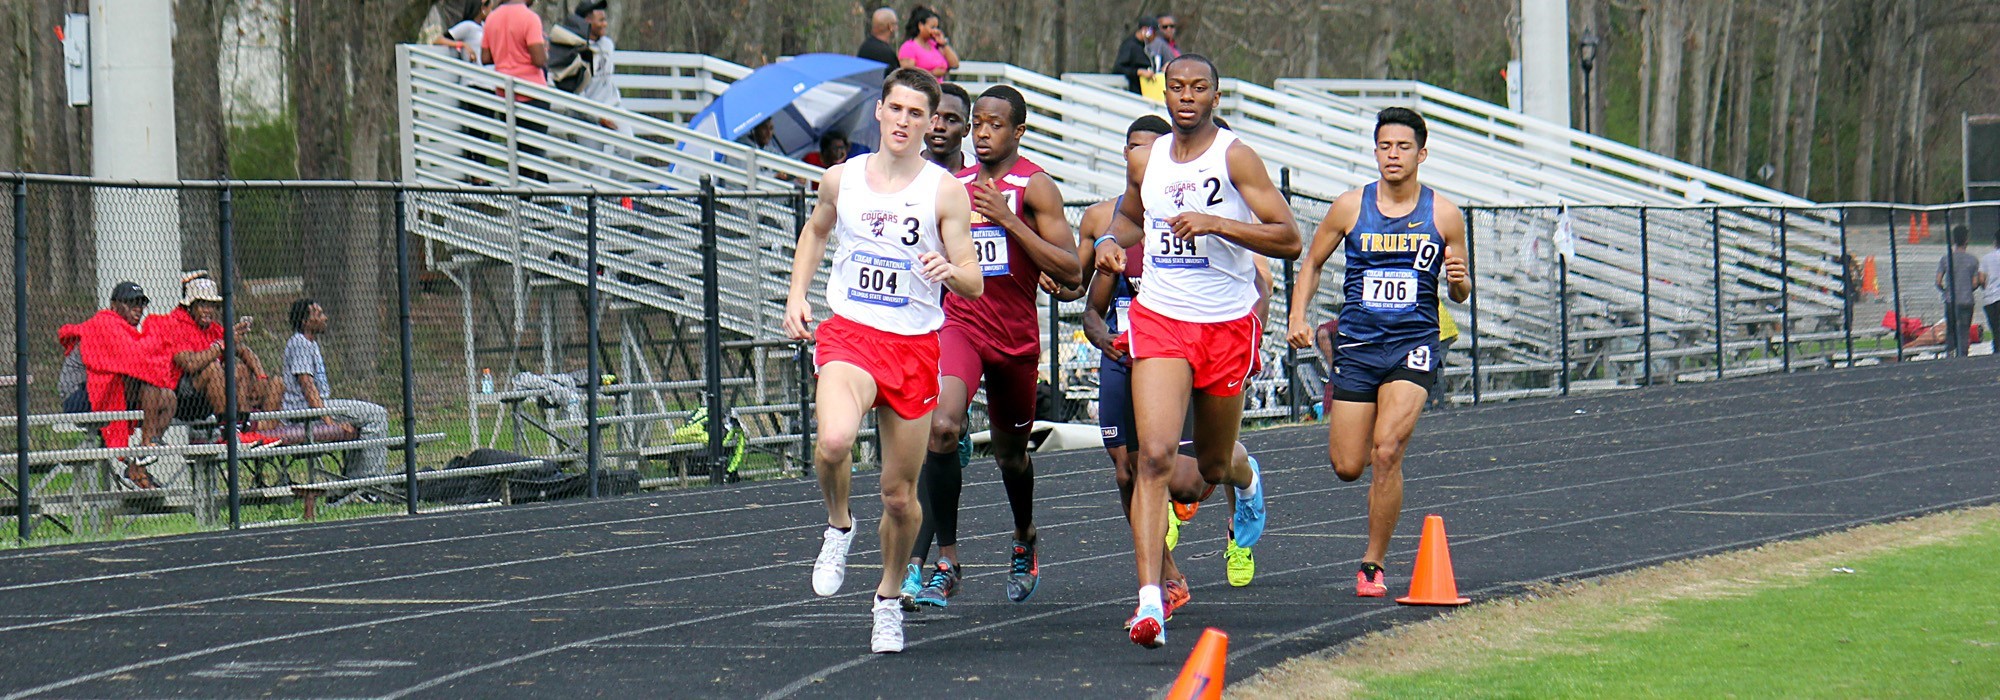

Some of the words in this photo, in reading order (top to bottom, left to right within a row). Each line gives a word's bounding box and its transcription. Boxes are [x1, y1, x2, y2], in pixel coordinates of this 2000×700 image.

[1164, 182, 1197, 195] COUGARS
[1203, 177, 1223, 206] 2
[861, 212, 898, 224] COUGARS
[901, 217, 920, 246] 3
[1160, 232, 1196, 256] 594
[854, 253, 873, 265] COUGAR
[873, 258, 907, 270] INVITATIONAL
[1419, 244, 1436, 269] 9
[859, 266, 898, 294] 604
[1366, 270, 1383, 278] COUGAR
[1384, 271, 1413, 279] INVITATIONAL
[850, 289, 869, 299] COLUMBUS
[869, 293, 882, 301] STATE
[882, 295, 905, 304] UNIVERSITY
[1373, 280, 1406, 300] 706
[1412, 349, 1428, 366] 9
